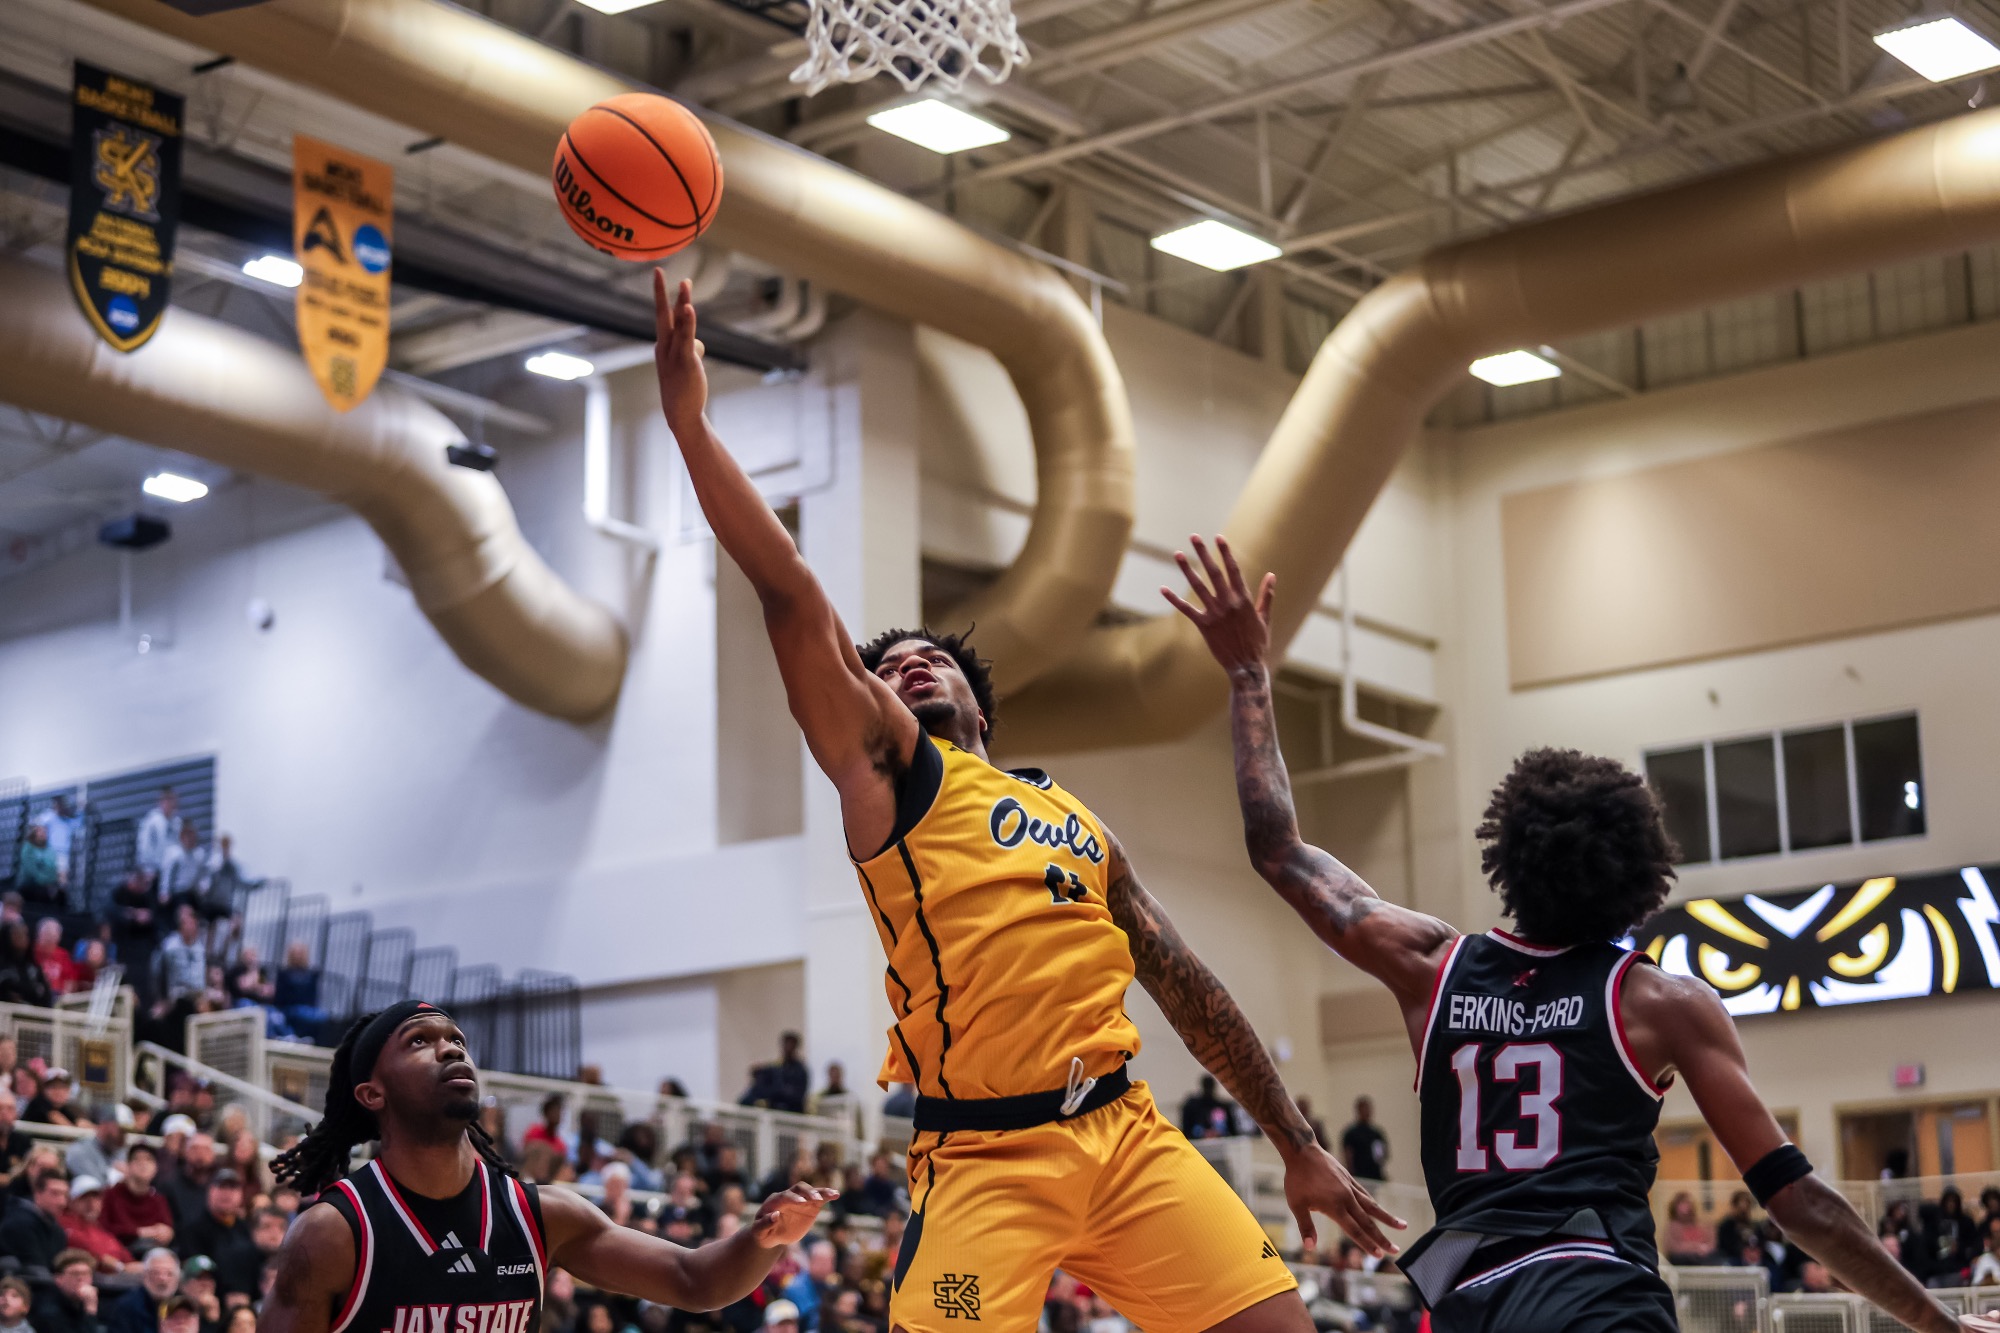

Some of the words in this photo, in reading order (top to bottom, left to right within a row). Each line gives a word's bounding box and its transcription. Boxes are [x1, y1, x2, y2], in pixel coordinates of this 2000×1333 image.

[556, 153, 635, 243] Wilson
[990, 796, 1105, 866] Owls
[1448, 993, 1584, 1036] ERKINS-FORD
[1450, 1041, 1565, 1173] 13
[381, 1303, 452, 1333] JAX
[455, 1298, 535, 1333] STATE
